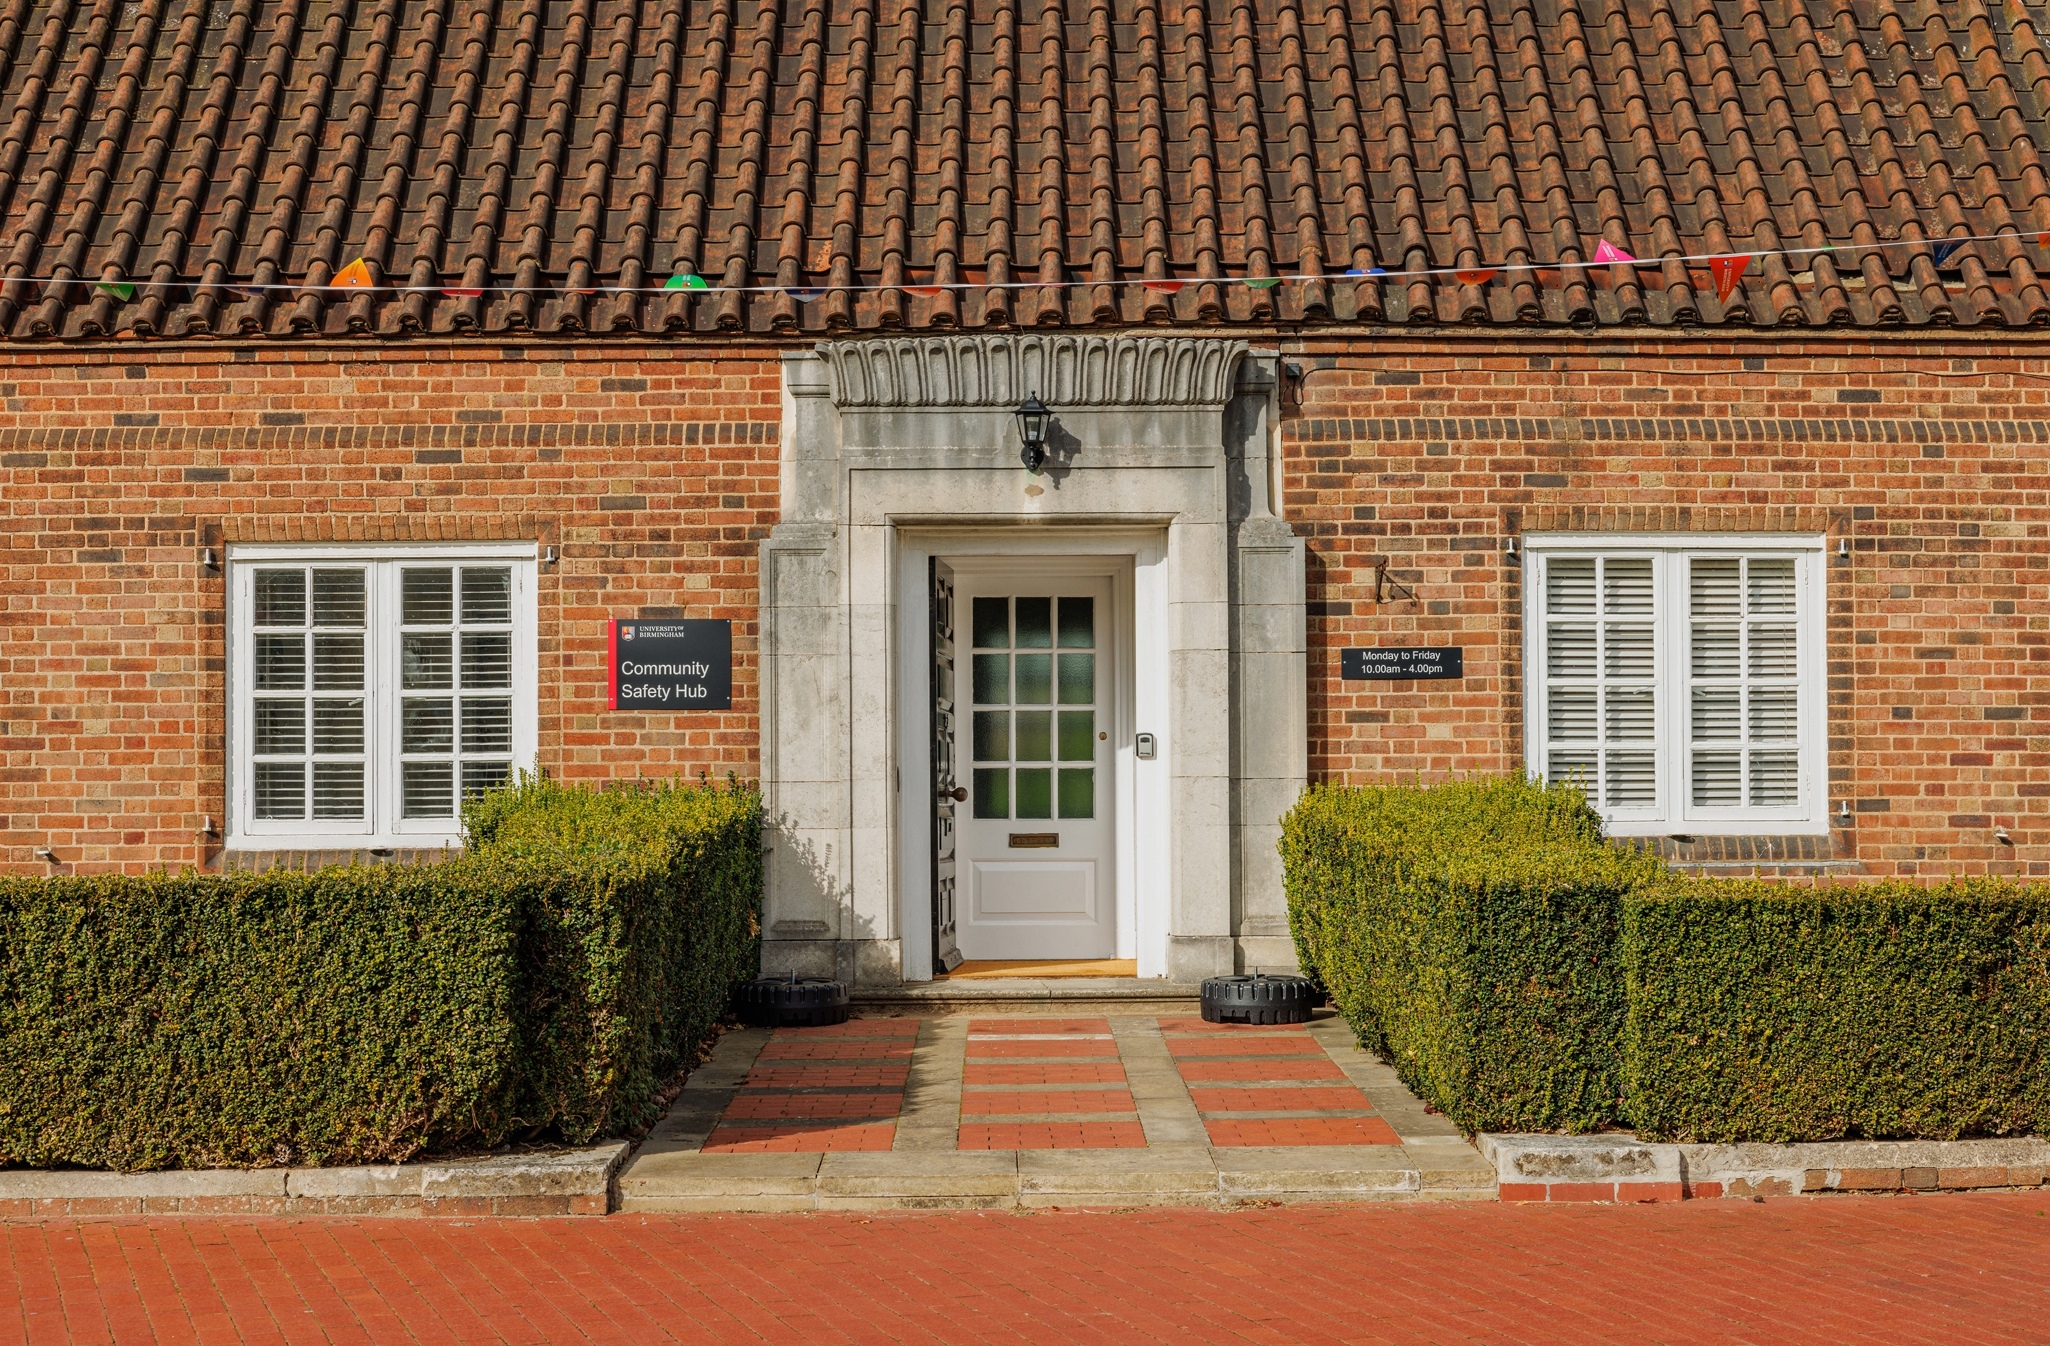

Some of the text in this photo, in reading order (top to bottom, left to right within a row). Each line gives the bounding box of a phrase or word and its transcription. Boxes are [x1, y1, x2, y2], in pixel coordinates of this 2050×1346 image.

[1362, 650, 1441, 662] Monday to Friday
[621, 661, 709, 679] Community
[1361, 664, 1400, 674] 10.00am
[1408, 664, 1443, 675] 4.00pm
[621, 684, 707, 702] Safety Hub
